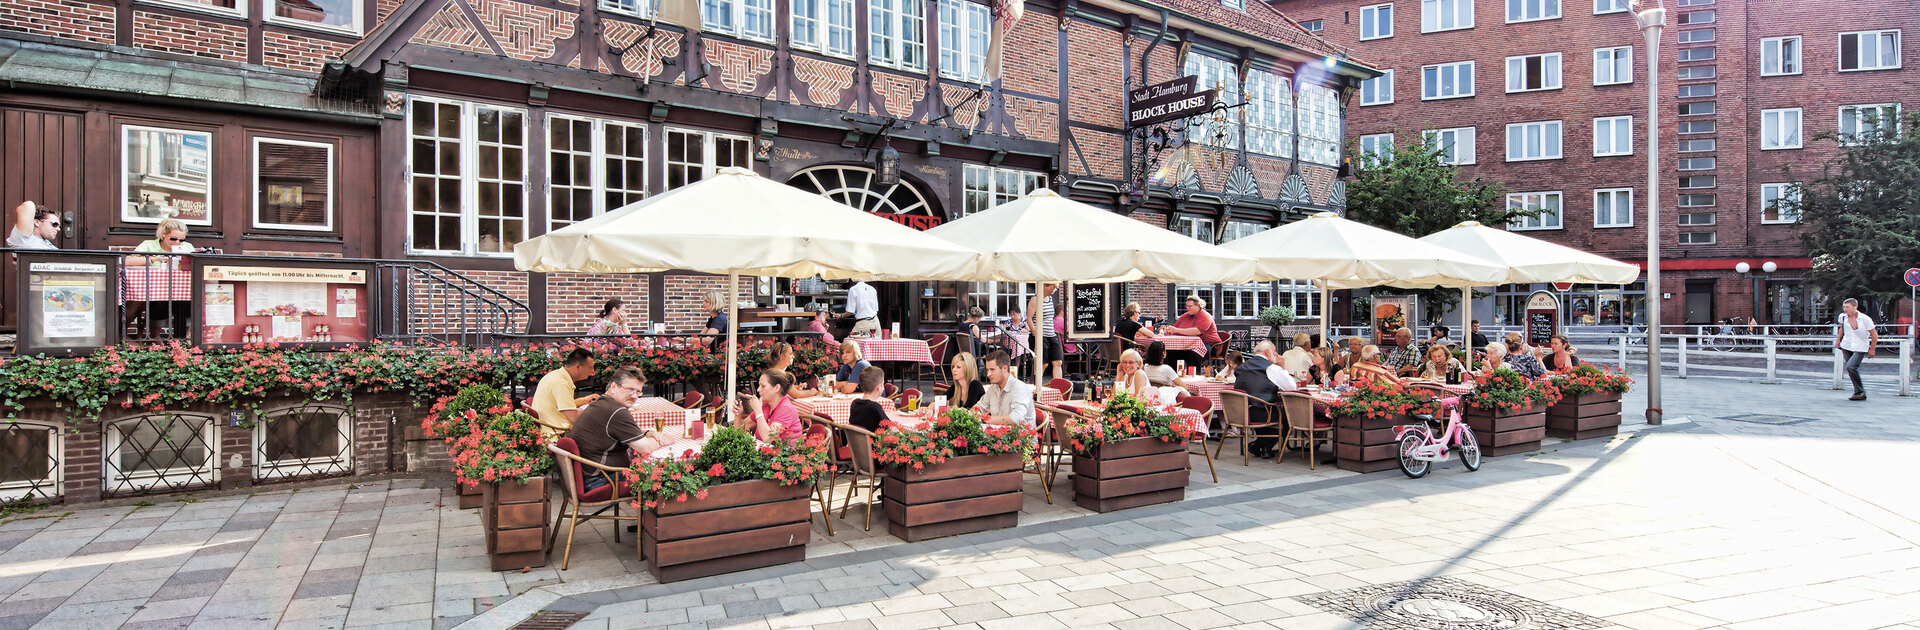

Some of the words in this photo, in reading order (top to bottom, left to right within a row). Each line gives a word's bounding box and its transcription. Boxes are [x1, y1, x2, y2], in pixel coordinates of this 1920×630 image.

[1131, 89, 1150, 104] Stadt
[1150, 82, 1188, 99] Hamburg
[1131, 104, 1166, 122] BLOCK
[1167, 95, 1206, 114] HOUSE
[867, 211, 942, 232] OUSE
